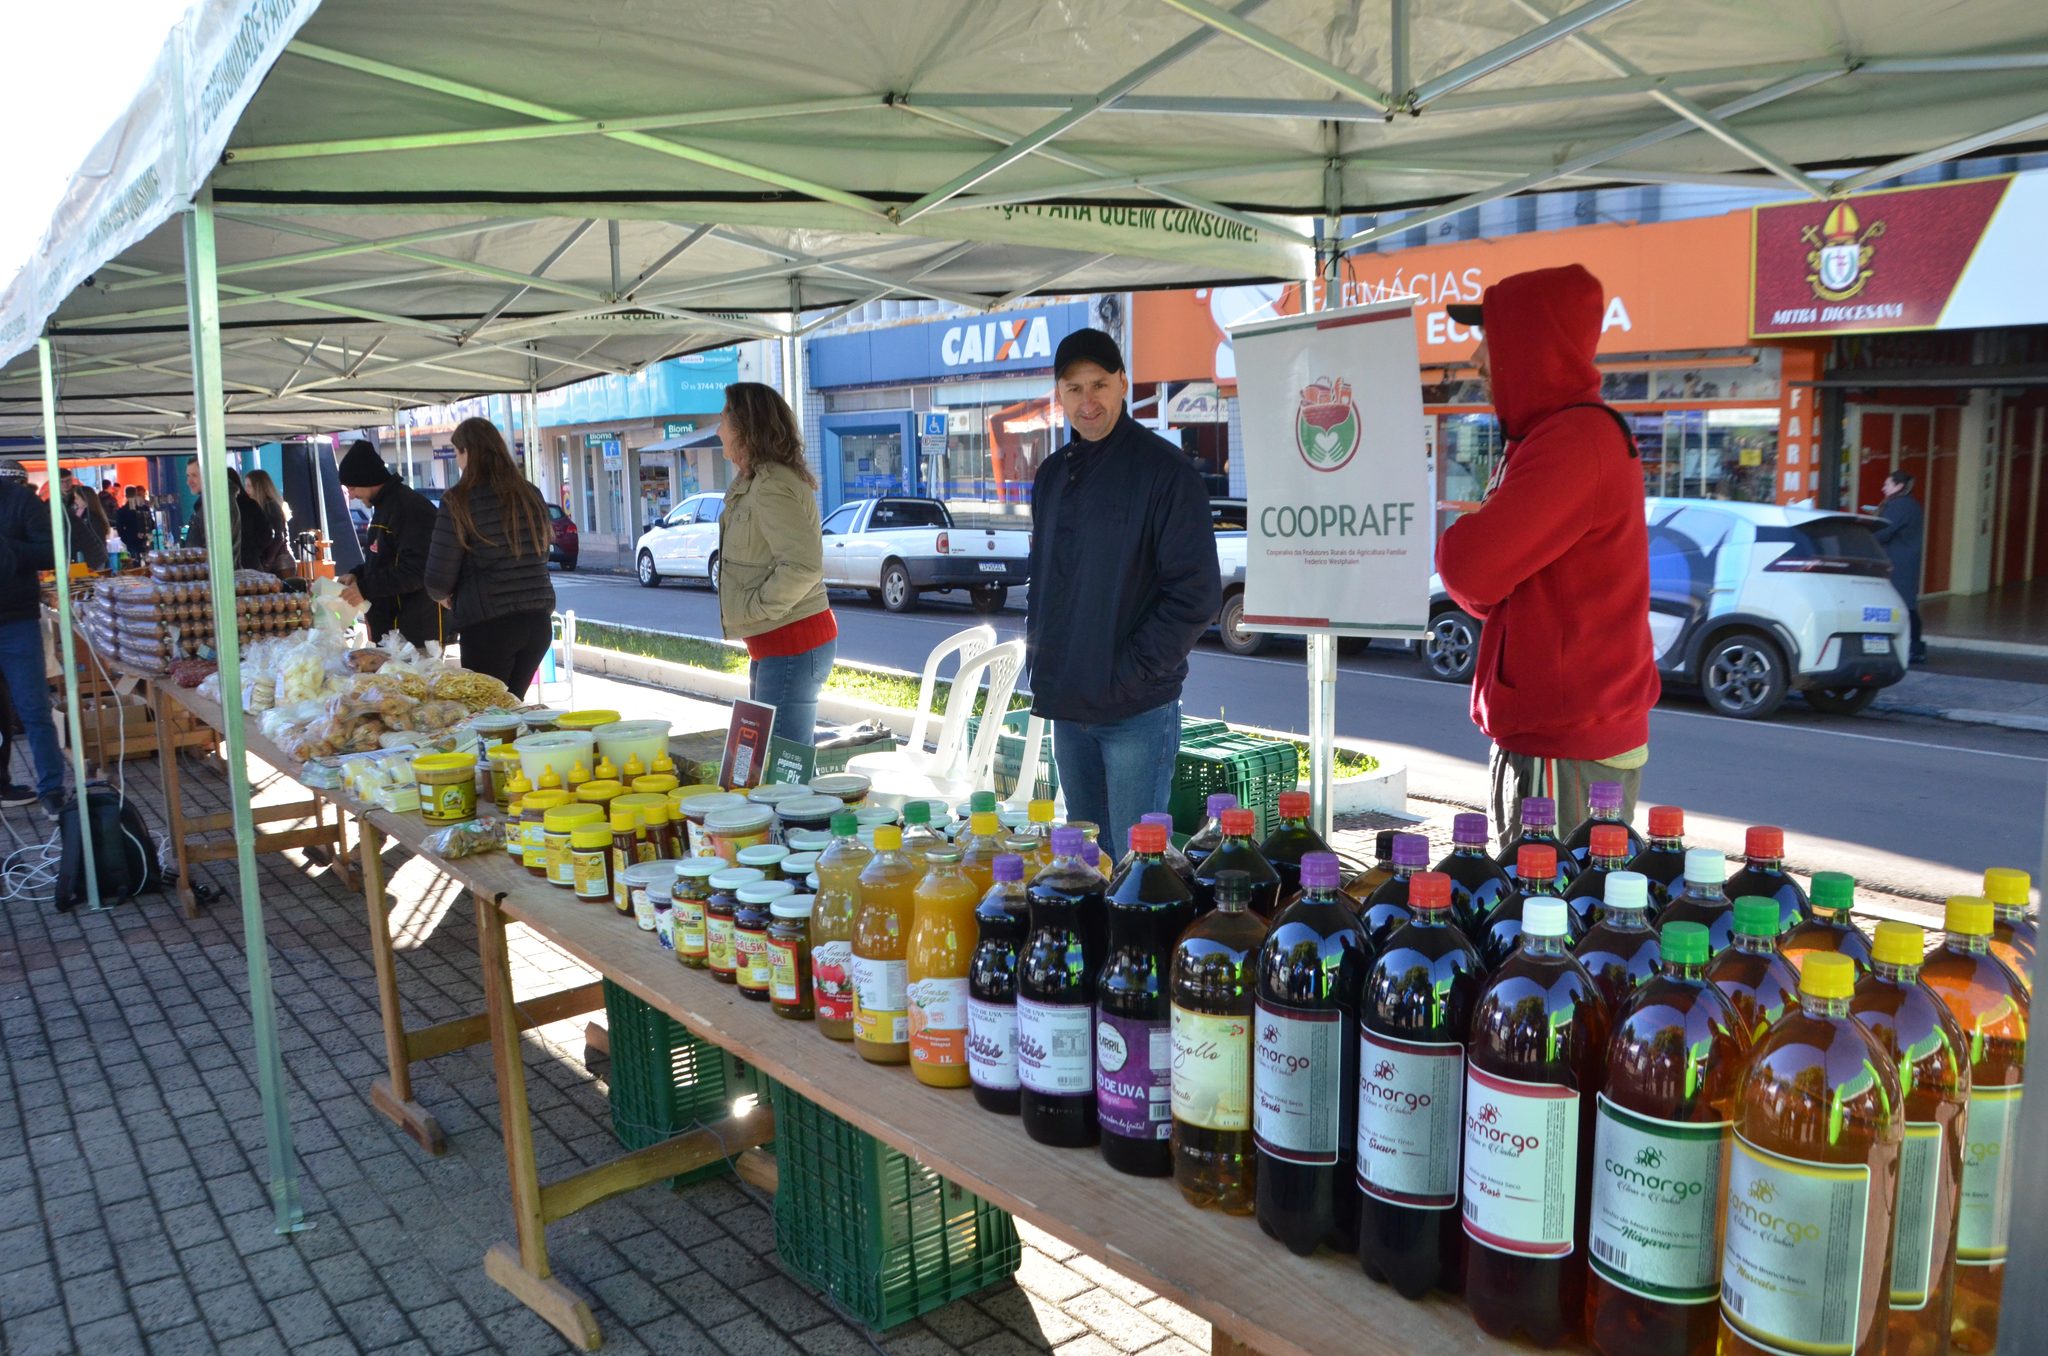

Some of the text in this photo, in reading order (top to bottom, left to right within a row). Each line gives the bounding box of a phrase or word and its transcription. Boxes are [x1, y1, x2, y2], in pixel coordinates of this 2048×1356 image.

[1313, 267, 1482, 312] FRMÁCIAS
[941, 316, 1051, 366] CAIXA
[1260, 502, 1415, 538] COOPRAFF
[786, 770, 801, 785] Pix
[989, 1010, 1002, 1018] UVA
[940, 1055, 952, 1064] 1L
[1257, 1043, 1310, 1073] margo
[1104, 1078, 1117, 1093] DE
[1118, 1082, 1145, 1099] UVA
[1360, 1077, 1431, 1111] amargo
[1369, 1137, 1398, 1155] Suave
[1605, 1158, 1703, 1200] camargo
[1621, 1225, 1671, 1251] Niágara
